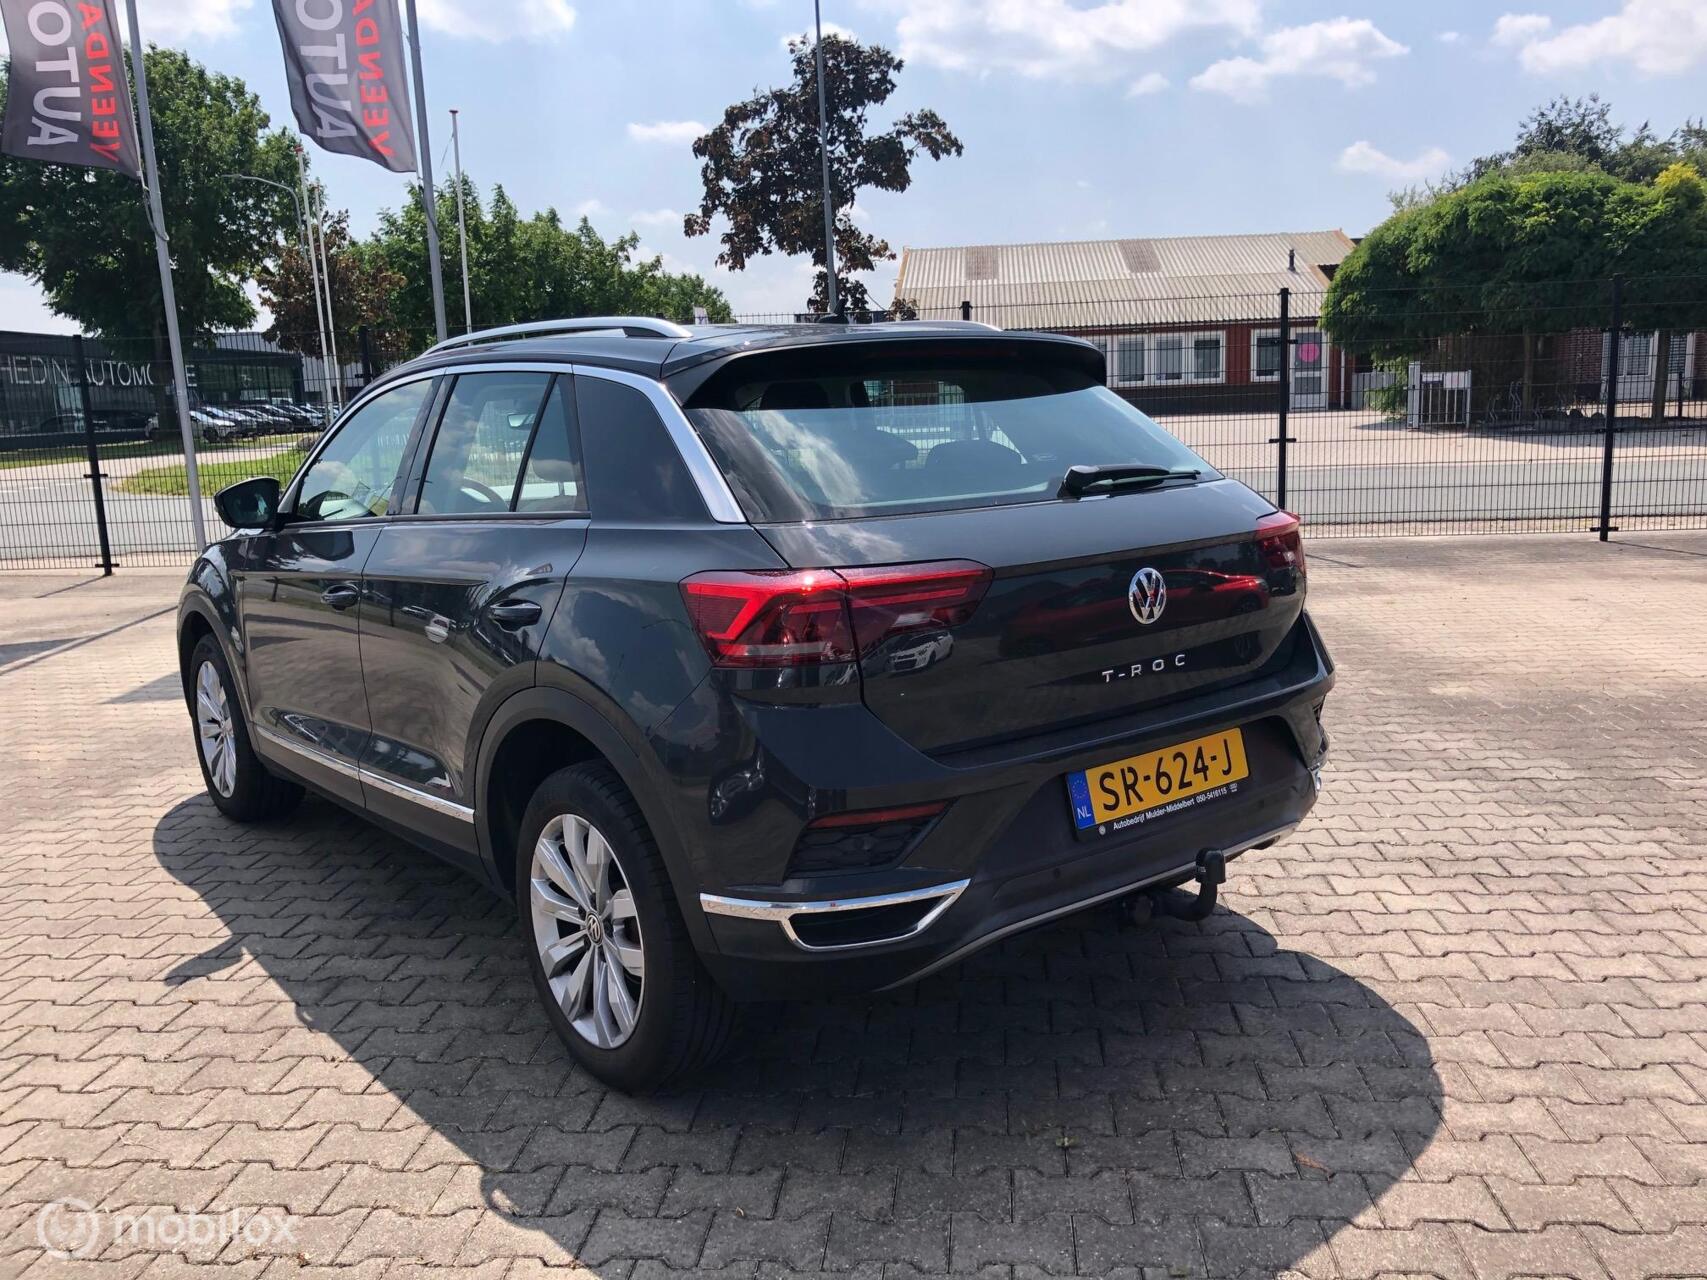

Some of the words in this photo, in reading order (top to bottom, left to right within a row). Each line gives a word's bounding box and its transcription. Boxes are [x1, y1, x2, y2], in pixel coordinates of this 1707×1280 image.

[1101, 653, 1186, 683] T-ROC
[1099, 738, 1233, 812] SR-624-J
[1076, 806, 1092, 820] NL
